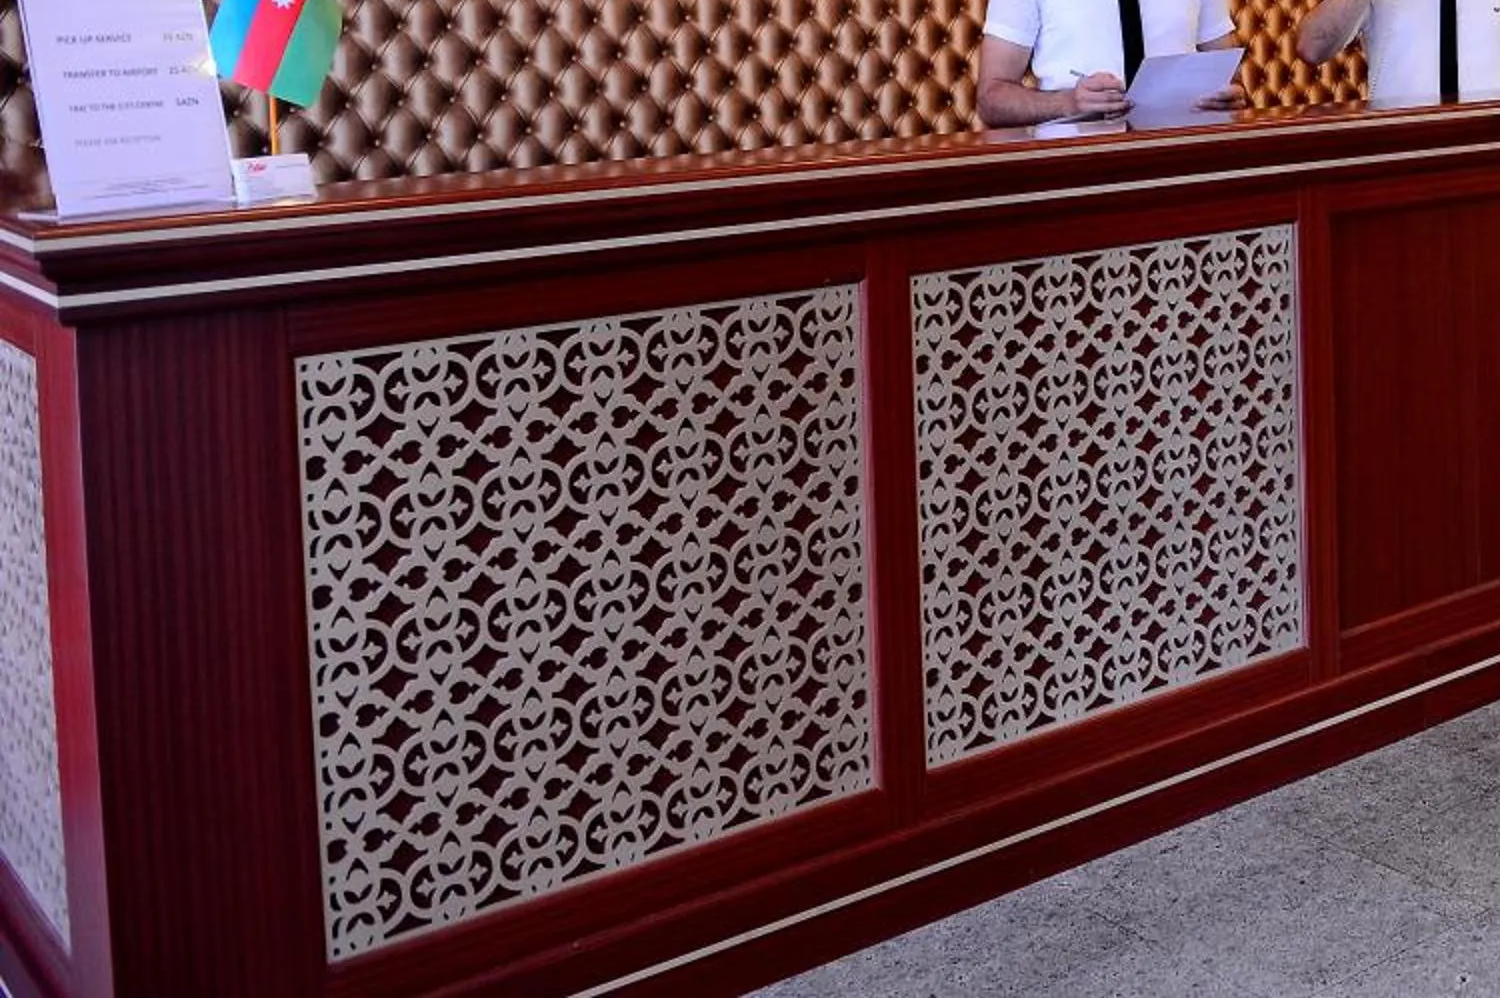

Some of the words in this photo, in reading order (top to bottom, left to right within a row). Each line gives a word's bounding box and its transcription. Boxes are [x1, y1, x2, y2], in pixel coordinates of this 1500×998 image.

[80, 35, 93, 44] UP
[95, 33, 131, 43] SERVICE
[63, 68, 106, 79] TRANSFER
[108, 68, 120, 77] TO
[122, 67, 158, 77] AIRPORT
